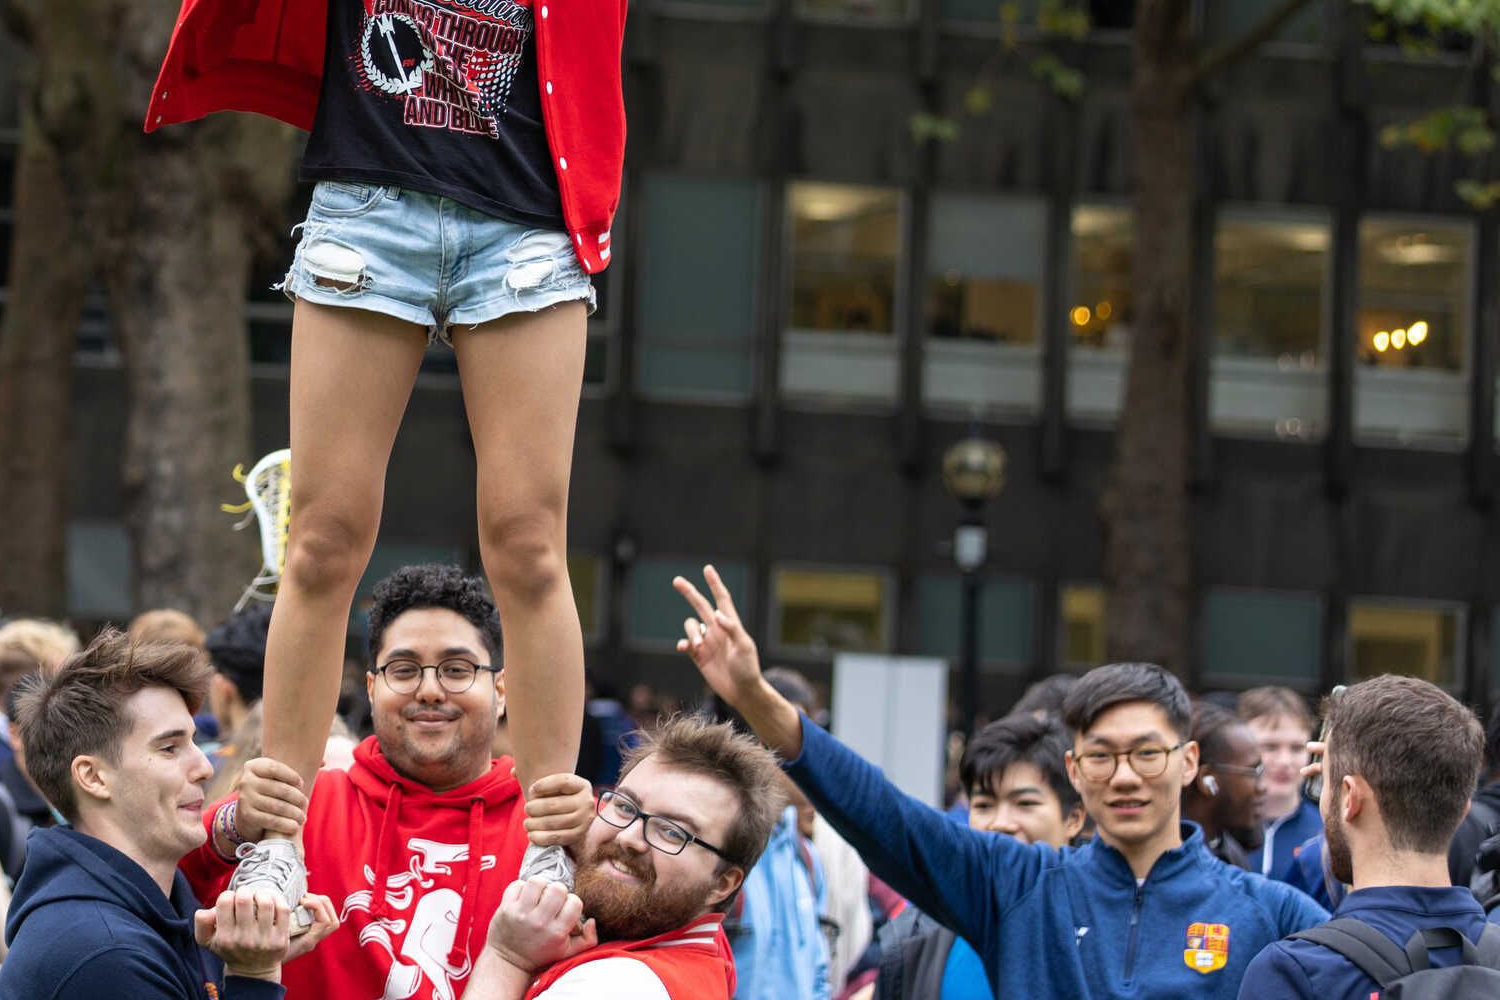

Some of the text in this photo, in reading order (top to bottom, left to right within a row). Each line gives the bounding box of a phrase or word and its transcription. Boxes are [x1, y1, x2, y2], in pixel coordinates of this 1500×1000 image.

[437, 10, 525, 56] THROUGH
[424, 72, 480, 113] WHITE
[405, 96, 500, 140] AND BLUE
